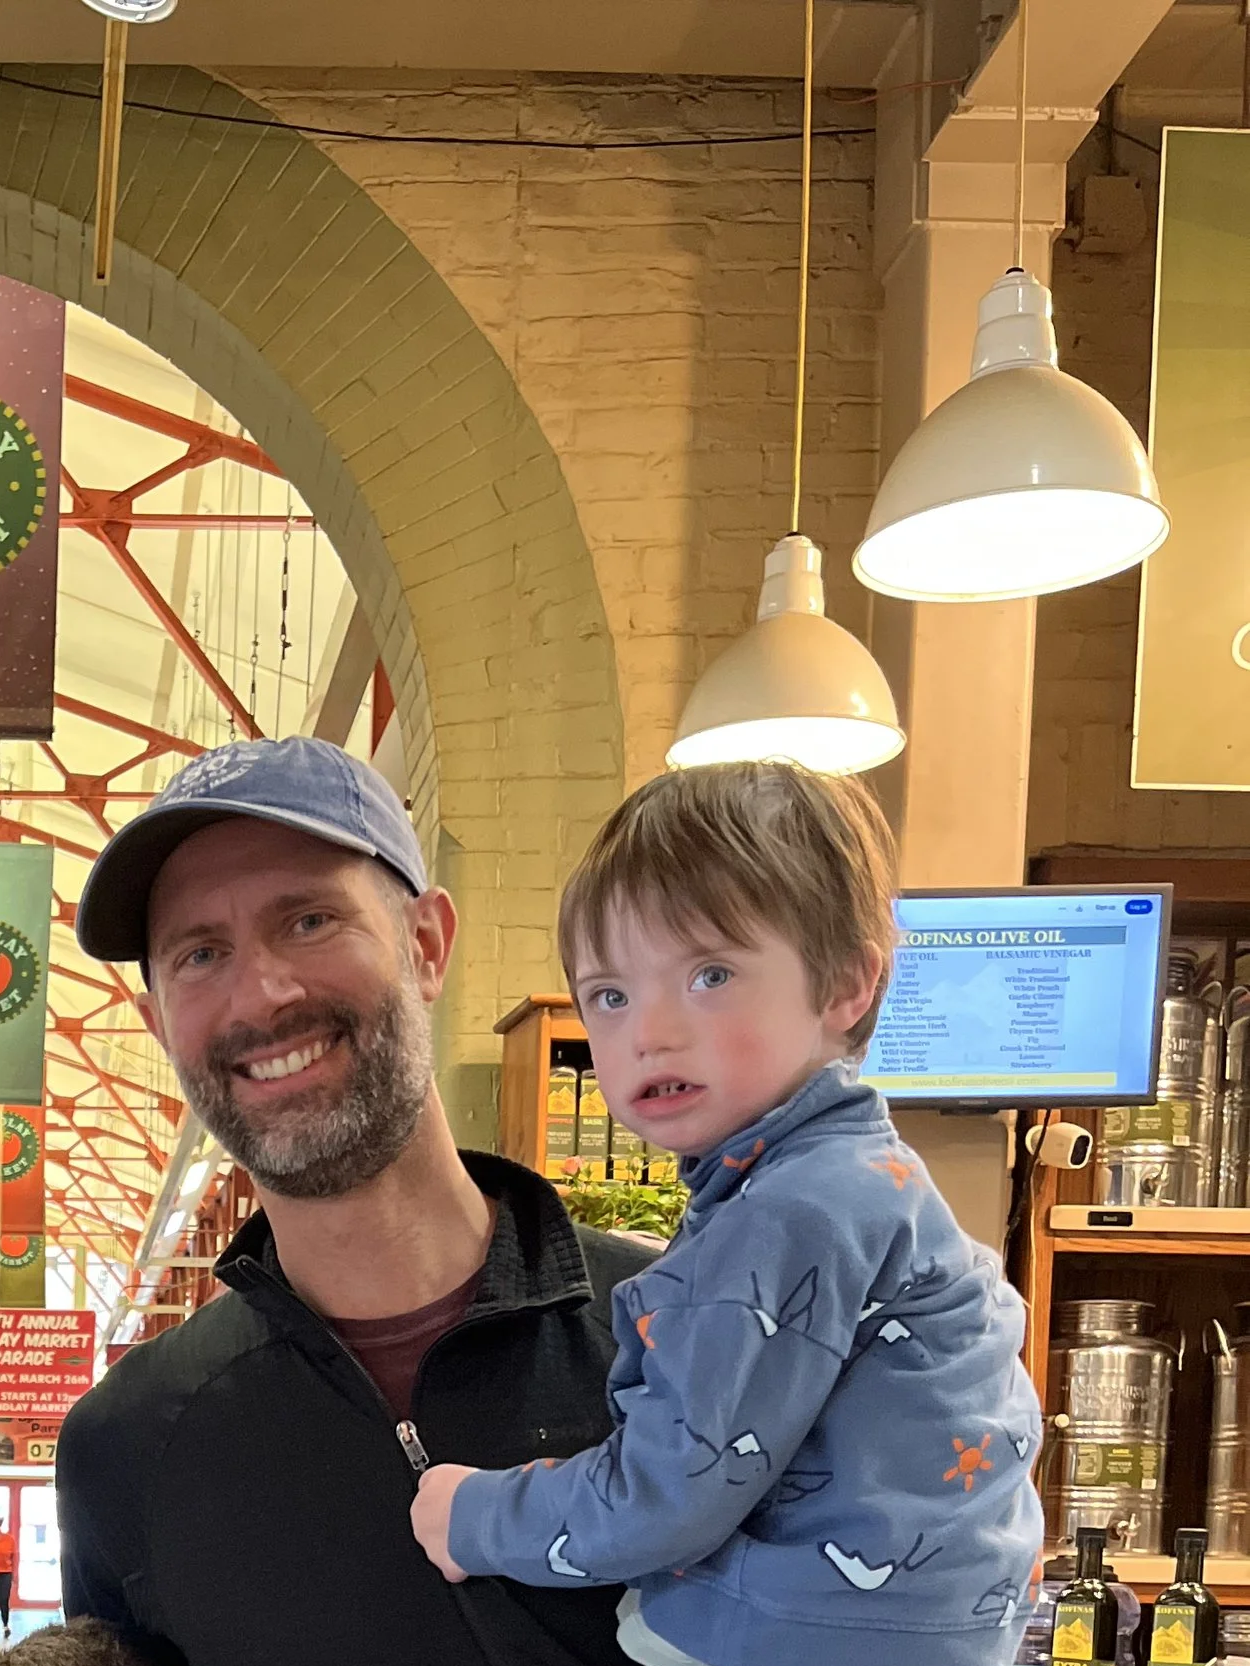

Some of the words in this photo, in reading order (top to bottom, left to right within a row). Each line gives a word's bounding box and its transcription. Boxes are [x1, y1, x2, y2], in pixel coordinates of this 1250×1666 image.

[976, 931, 1030, 946] OLIVE
[1034, 930, 1066, 944] OIL
[986, 950, 1040, 959] BALSAMIC
[1043, 949, 1091, 958] VINEGAR
[17, 1315, 79, 1330] ANNUAL
[24, 1333, 91, 1349] MARKET
[19, 1374, 61, 1384] MARCH
[64, 1375, 89, 1384] 26th
[1, 1391, 37, 1401] STARTS
[40, 1392, 54, 1401] AT
